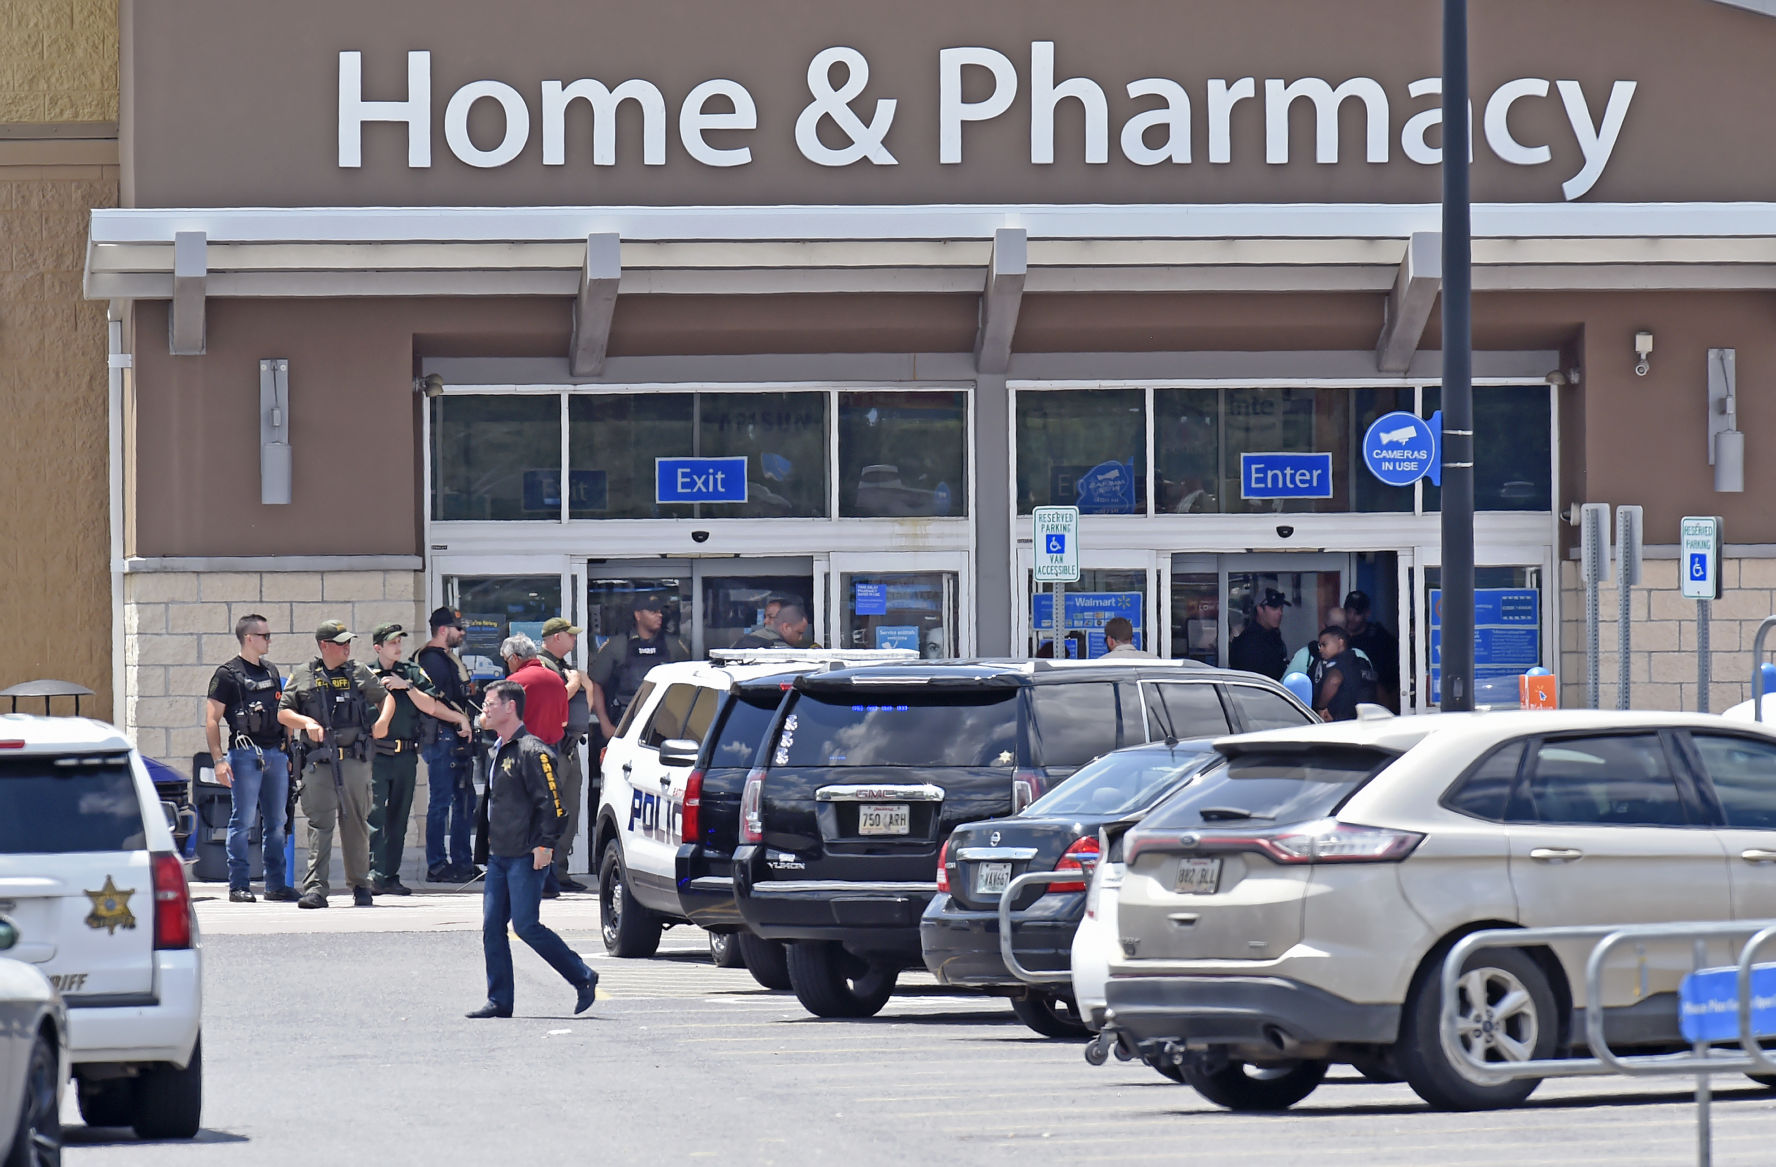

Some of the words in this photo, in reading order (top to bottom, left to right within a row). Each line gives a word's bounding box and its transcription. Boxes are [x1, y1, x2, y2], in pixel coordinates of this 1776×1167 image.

[337, 49, 757, 169] Home
[794, 45, 899, 167] &
[939, 40, 1638, 202] Pharmacy
[1373, 449, 1428, 460] CAMERAS
[1381, 461, 1394, 471] IN
[1395, 461, 1419, 471] USE
[676, 467, 726, 494] Exit
[1250, 463, 1322, 489] Enter
[1038, 513, 1074, 523] RESERVED
[1040, 523, 1072, 533] PARKING
[1684, 525, 1713, 537] RESERVED
[1686, 539, 1711, 550] PARKING
[1049, 554, 1064, 564] VAN
[1037, 565, 1077, 576] ACCESSIBLE
[1075, 597, 1116, 607] Walmart
[317, 678, 348, 689] SRIFF
[539, 753, 563, 817] SHERIFF
[855, 789, 896, 799] GMC
[627, 787, 683, 848] POLIC
[863, 813, 881, 827] 750
[888, 813, 907, 827] ARH
[767, 862, 806, 870] YUKON
[47, 973, 89, 992] RIFF
